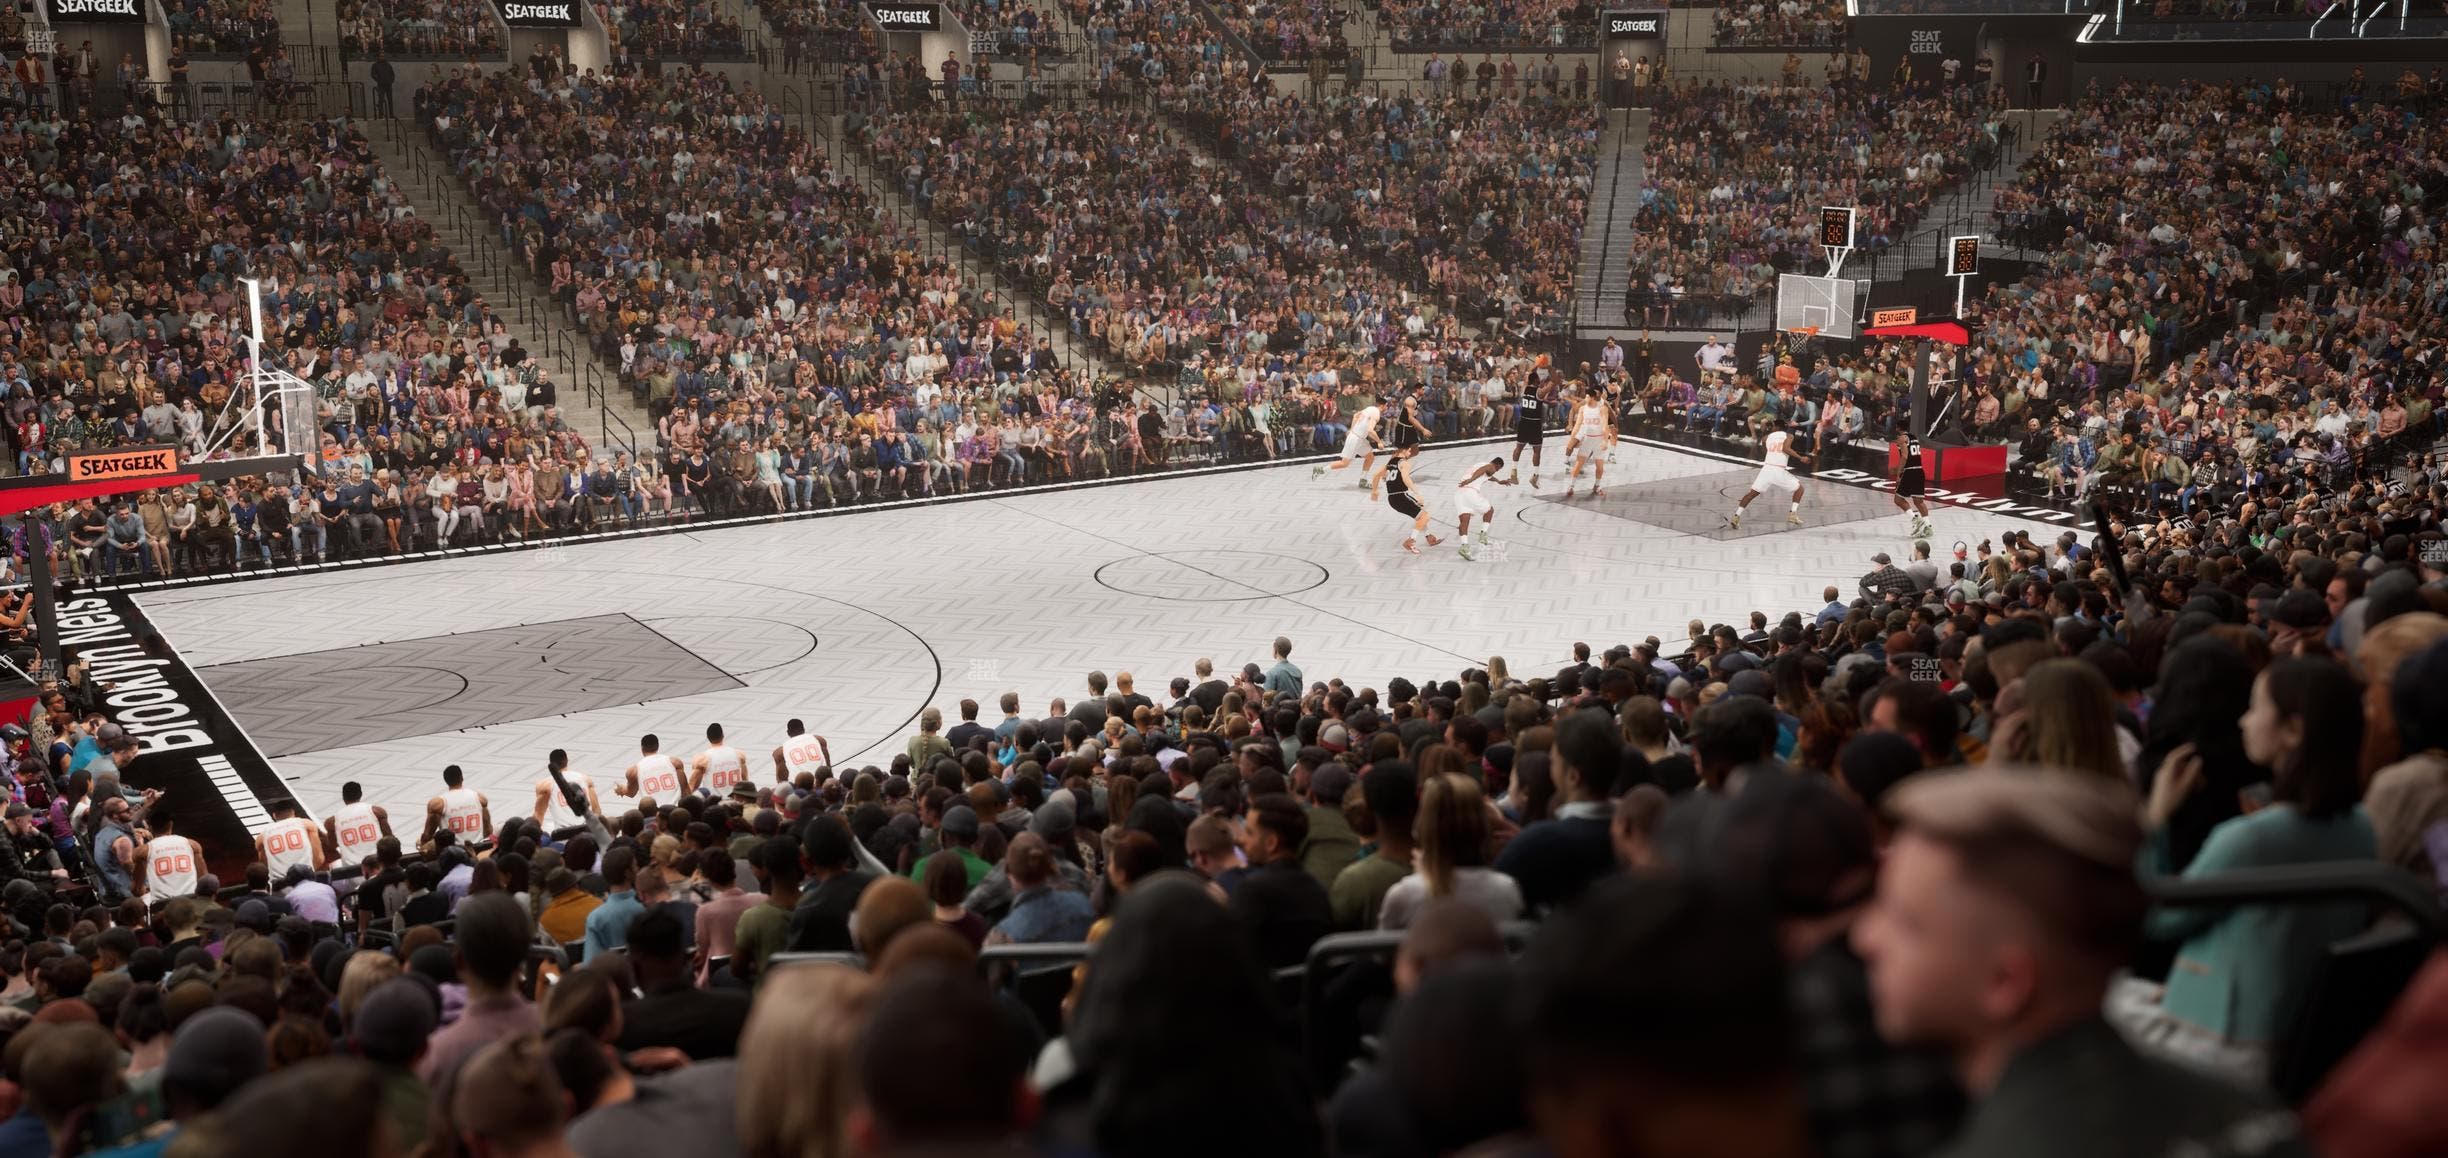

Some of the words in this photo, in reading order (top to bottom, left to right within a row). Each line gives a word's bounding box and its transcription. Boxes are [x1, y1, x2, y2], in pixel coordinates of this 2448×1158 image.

[57, 0, 138, 14] SEATGEEK
[505, 3, 571, 20] SEATGEEK
[876, 9, 931, 24] SEATGEEK
[1611, 20, 1656, 32] SEATGEEK
[1878, 311, 1912, 324] SEATGEEK
[80, 453, 168, 476] SEATGEEK
[55, 598, 132, 645] Nets
[77, 643, 214, 756] Brooklyn
[790, 743, 821, 765] 00
[643, 773, 676, 795] 00
[713, 769, 741, 788] 00
[448, 813, 480, 834] 00
[267, 830, 304, 855] 00
[340, 823, 377, 847] 00
[154, 854, 192, 877] 00
